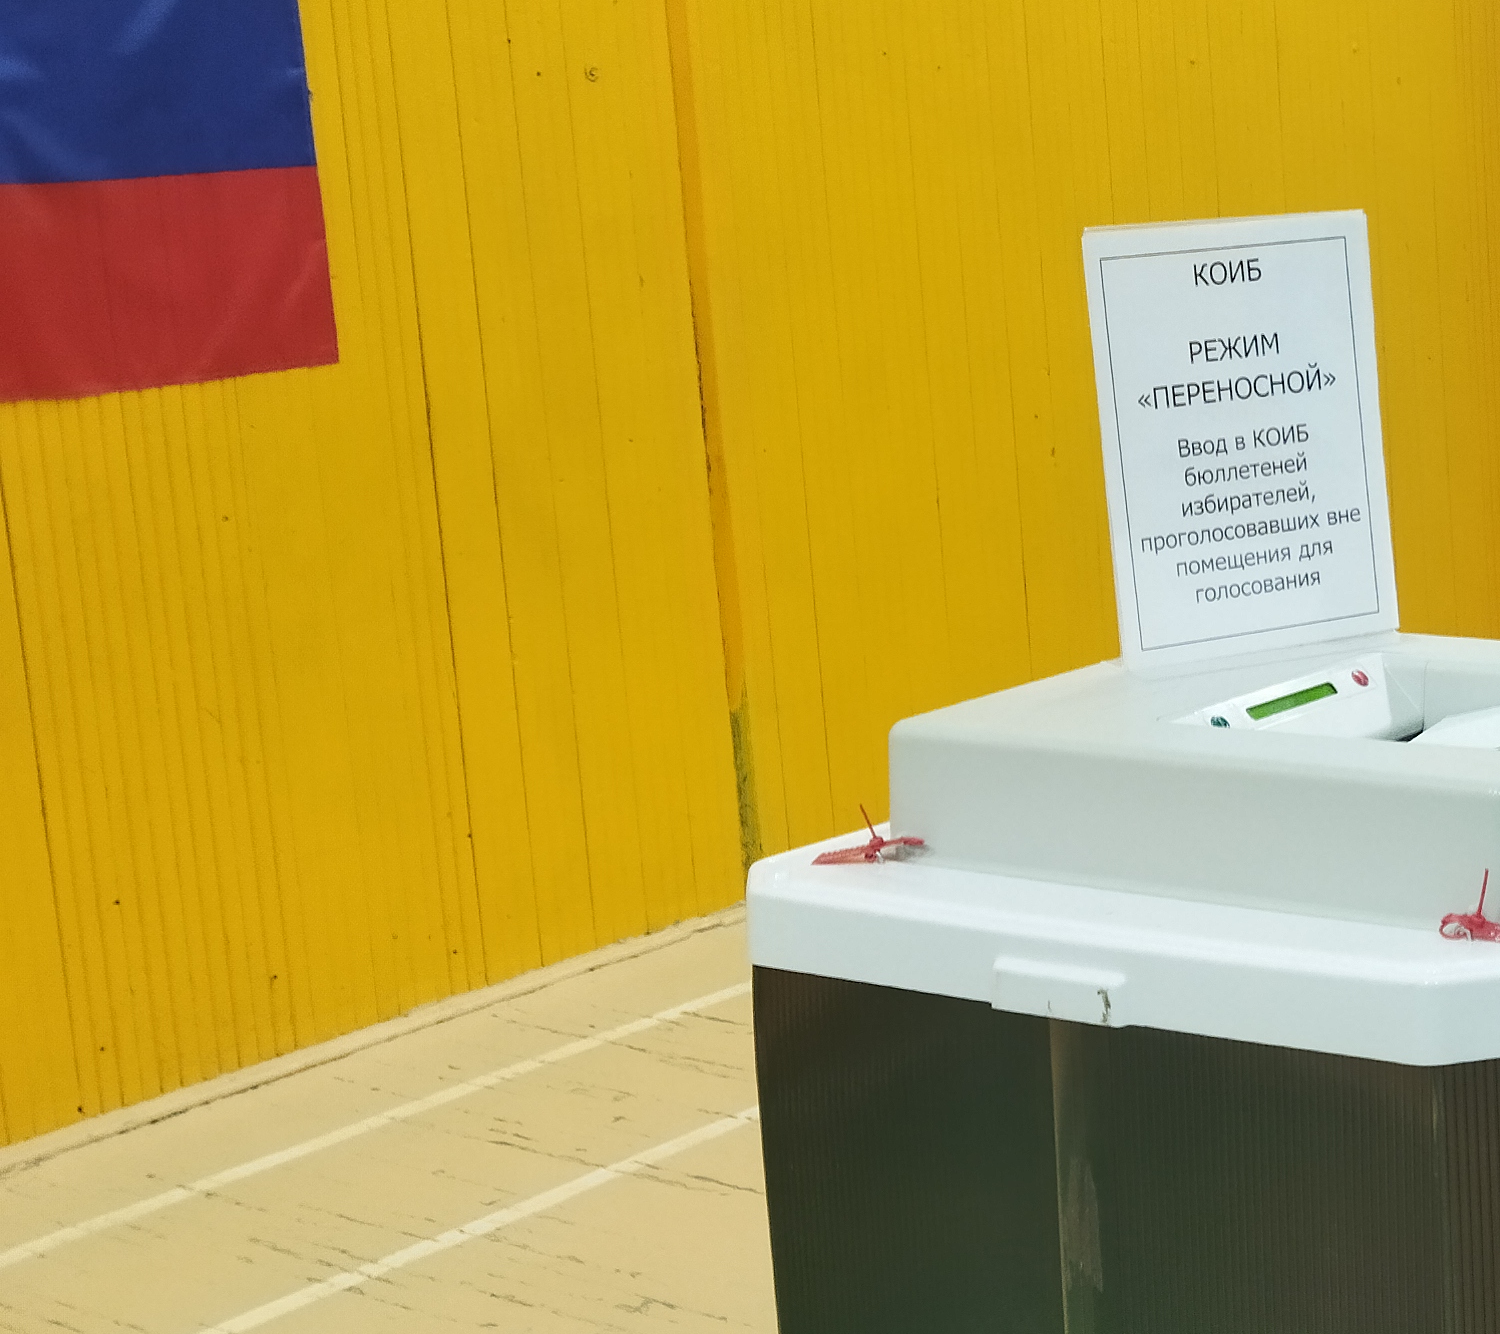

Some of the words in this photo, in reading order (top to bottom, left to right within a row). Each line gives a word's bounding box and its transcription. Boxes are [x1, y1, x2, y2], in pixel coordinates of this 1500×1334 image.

[1193, 258, 1262, 287] КОИБ
[1188, 332, 1280, 364] РЕЖИМ
[1137, 362, 1336, 410] «ПЕРЕНОСНОЙ»
[1177, 437, 1228, 458] Ввод
[1235, 436, 1246, 451] в
[1252, 423, 1309, 449] КОИБ
[1184, 451, 1308, 487] бюллетеней
[1181, 480, 1316, 517] избирателей,
[1141, 513, 1320, 555] проголосовавших
[1327, 507, 1361, 526] вне
[1176, 547, 1291, 577] помещения
[1299, 540, 1333, 562] для
[1195, 571, 1321, 604] голосования
